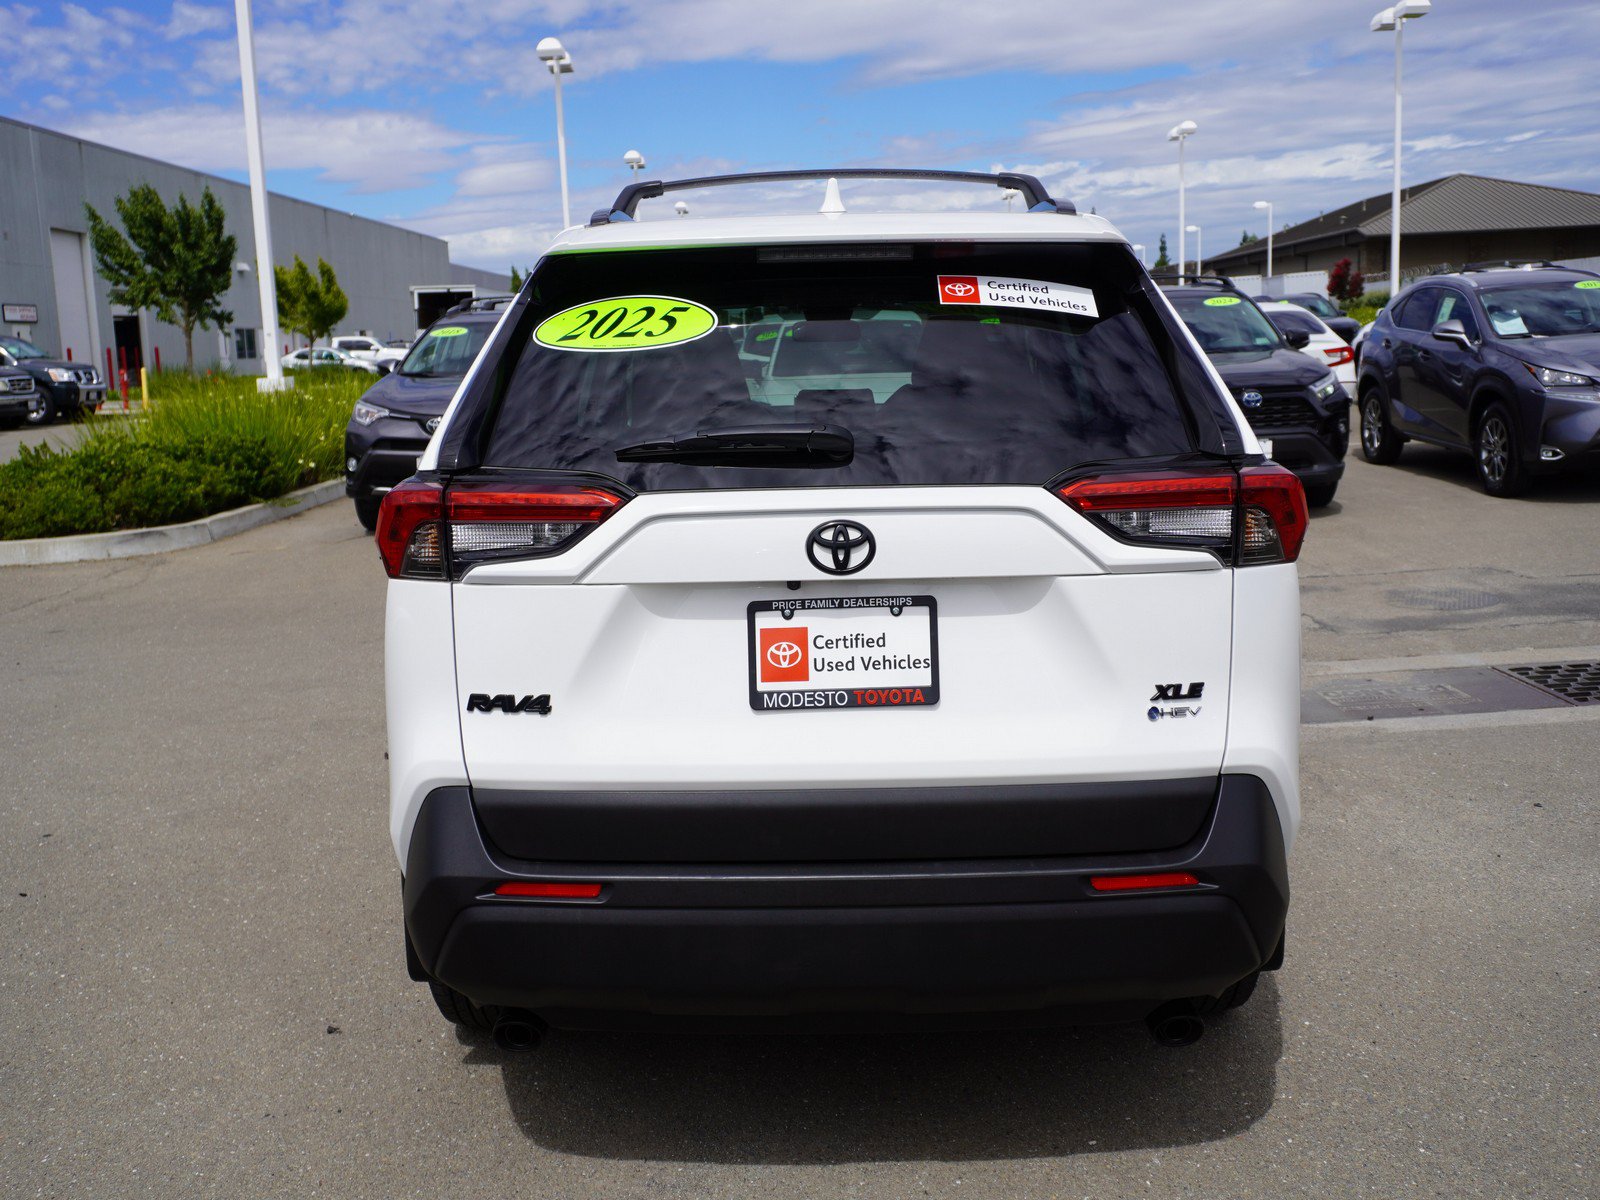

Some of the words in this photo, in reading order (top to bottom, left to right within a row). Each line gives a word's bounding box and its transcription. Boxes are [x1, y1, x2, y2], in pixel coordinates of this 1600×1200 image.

[987, 280, 1049, 294] Certified
[988, 292, 1025, 303] Used
[1029, 295, 1088, 312] Vehicles
[555, 305, 691, 343] 2025
[772, 600, 802, 610] PRICE
[805, 599, 841, 609] FAMILY
[843, 597, 912, 608] DEALERSHIPS
[813, 633, 886, 650] Certified
[813, 656, 855, 672] Used
[861, 655, 931, 670] Vehicles
[763, 690, 848, 708] MODESTO
[853, 688, 925, 705] TOYOTA
[1150, 681, 1205, 701] XLE
[466, 692, 552, 715] RAV4
[1158, 706, 1202, 719] HEV
